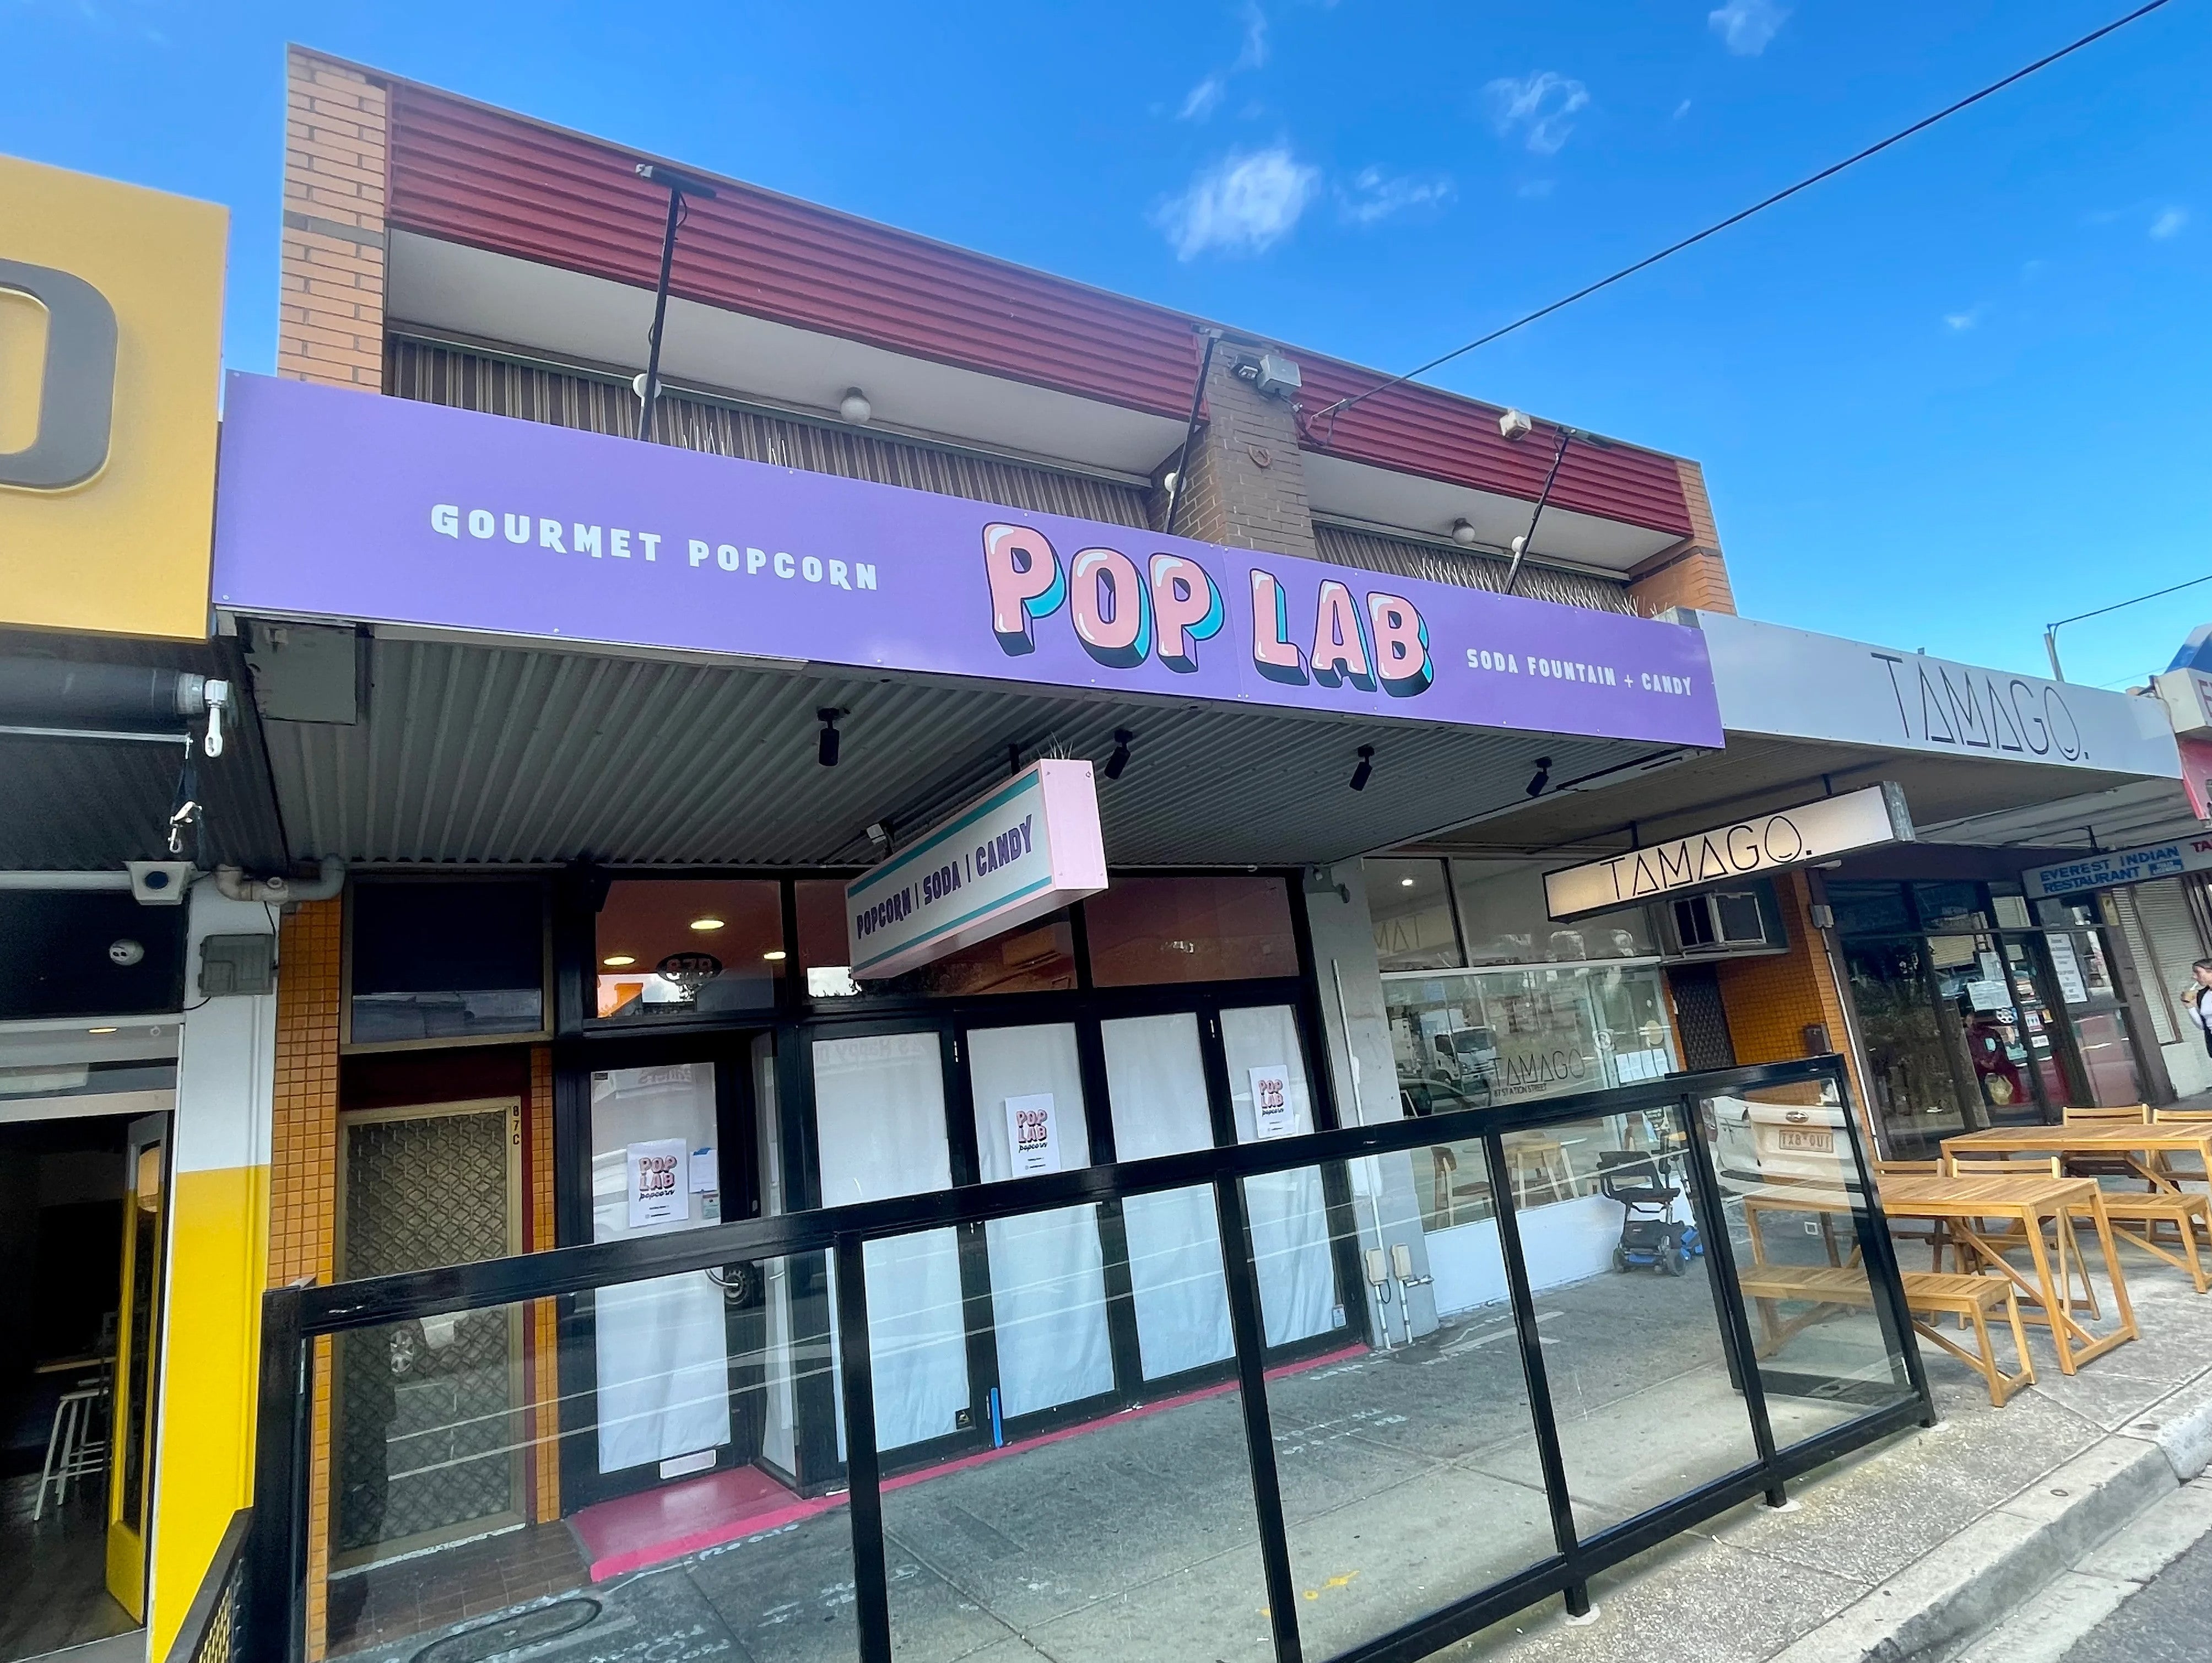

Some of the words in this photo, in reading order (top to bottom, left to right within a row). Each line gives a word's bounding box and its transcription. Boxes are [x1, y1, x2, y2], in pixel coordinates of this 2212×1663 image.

[431, 504, 661, 562] GOURMET
[688, 539, 878, 591] POPCORN
[982, 522, 1224, 673] POP
[1250, 568, 1434, 698] LAB
[1467, 648, 1518, 673] SODA
[1527, 656, 1617, 687] FOUNTAIN
[1641, 672, 1692, 696] CANDY
[856, 883, 912, 940] POPCORN
[923, 861, 961, 905] SODA
[976, 813, 1033, 877] CANDY
[2040, 859, 2111, 882] EVEREST
[2120, 846, 2179, 867] INDIAN
[2043, 866, 2141, 894] RESTAURANT
[1488, 1048, 1586, 1088] TAMAGO
[1258, 1079, 1284, 1096] POP
[1016, 1109, 1048, 1128] POP
[1018, 1126, 1047, 1143] LAB
[639, 1155, 678, 1175] POP
[639, 1173, 675, 1191] LAB
